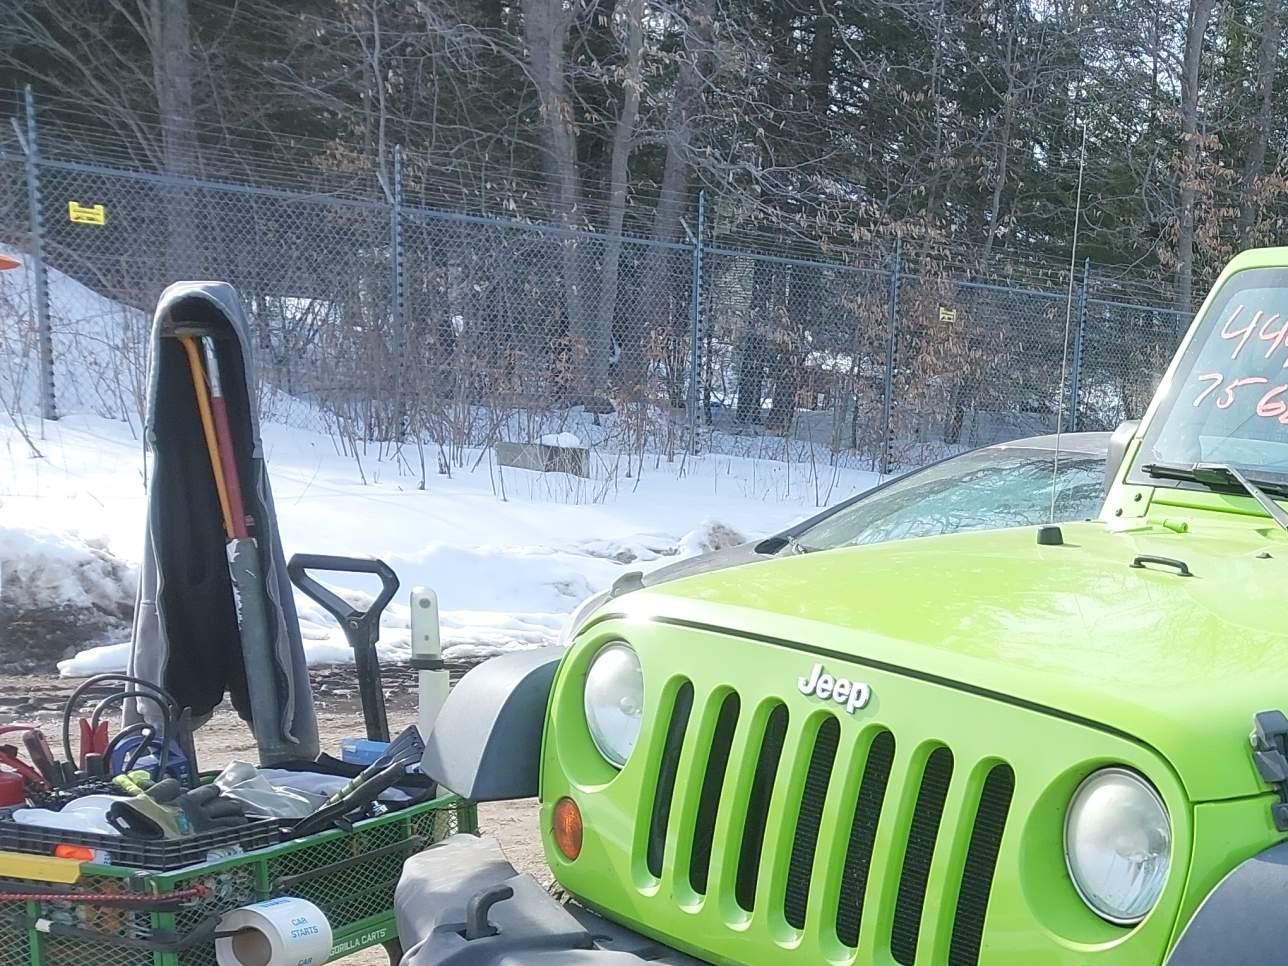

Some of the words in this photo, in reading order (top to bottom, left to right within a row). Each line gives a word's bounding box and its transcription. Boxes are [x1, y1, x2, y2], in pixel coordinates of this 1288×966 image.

[798, 663, 872, 715] Jeep
[291, 917, 307, 926] CAR
[291, 926, 319, 938] STARTS
[330, 940, 360, 956] GORILLA
[361, 928, 386, 943] CARTS
